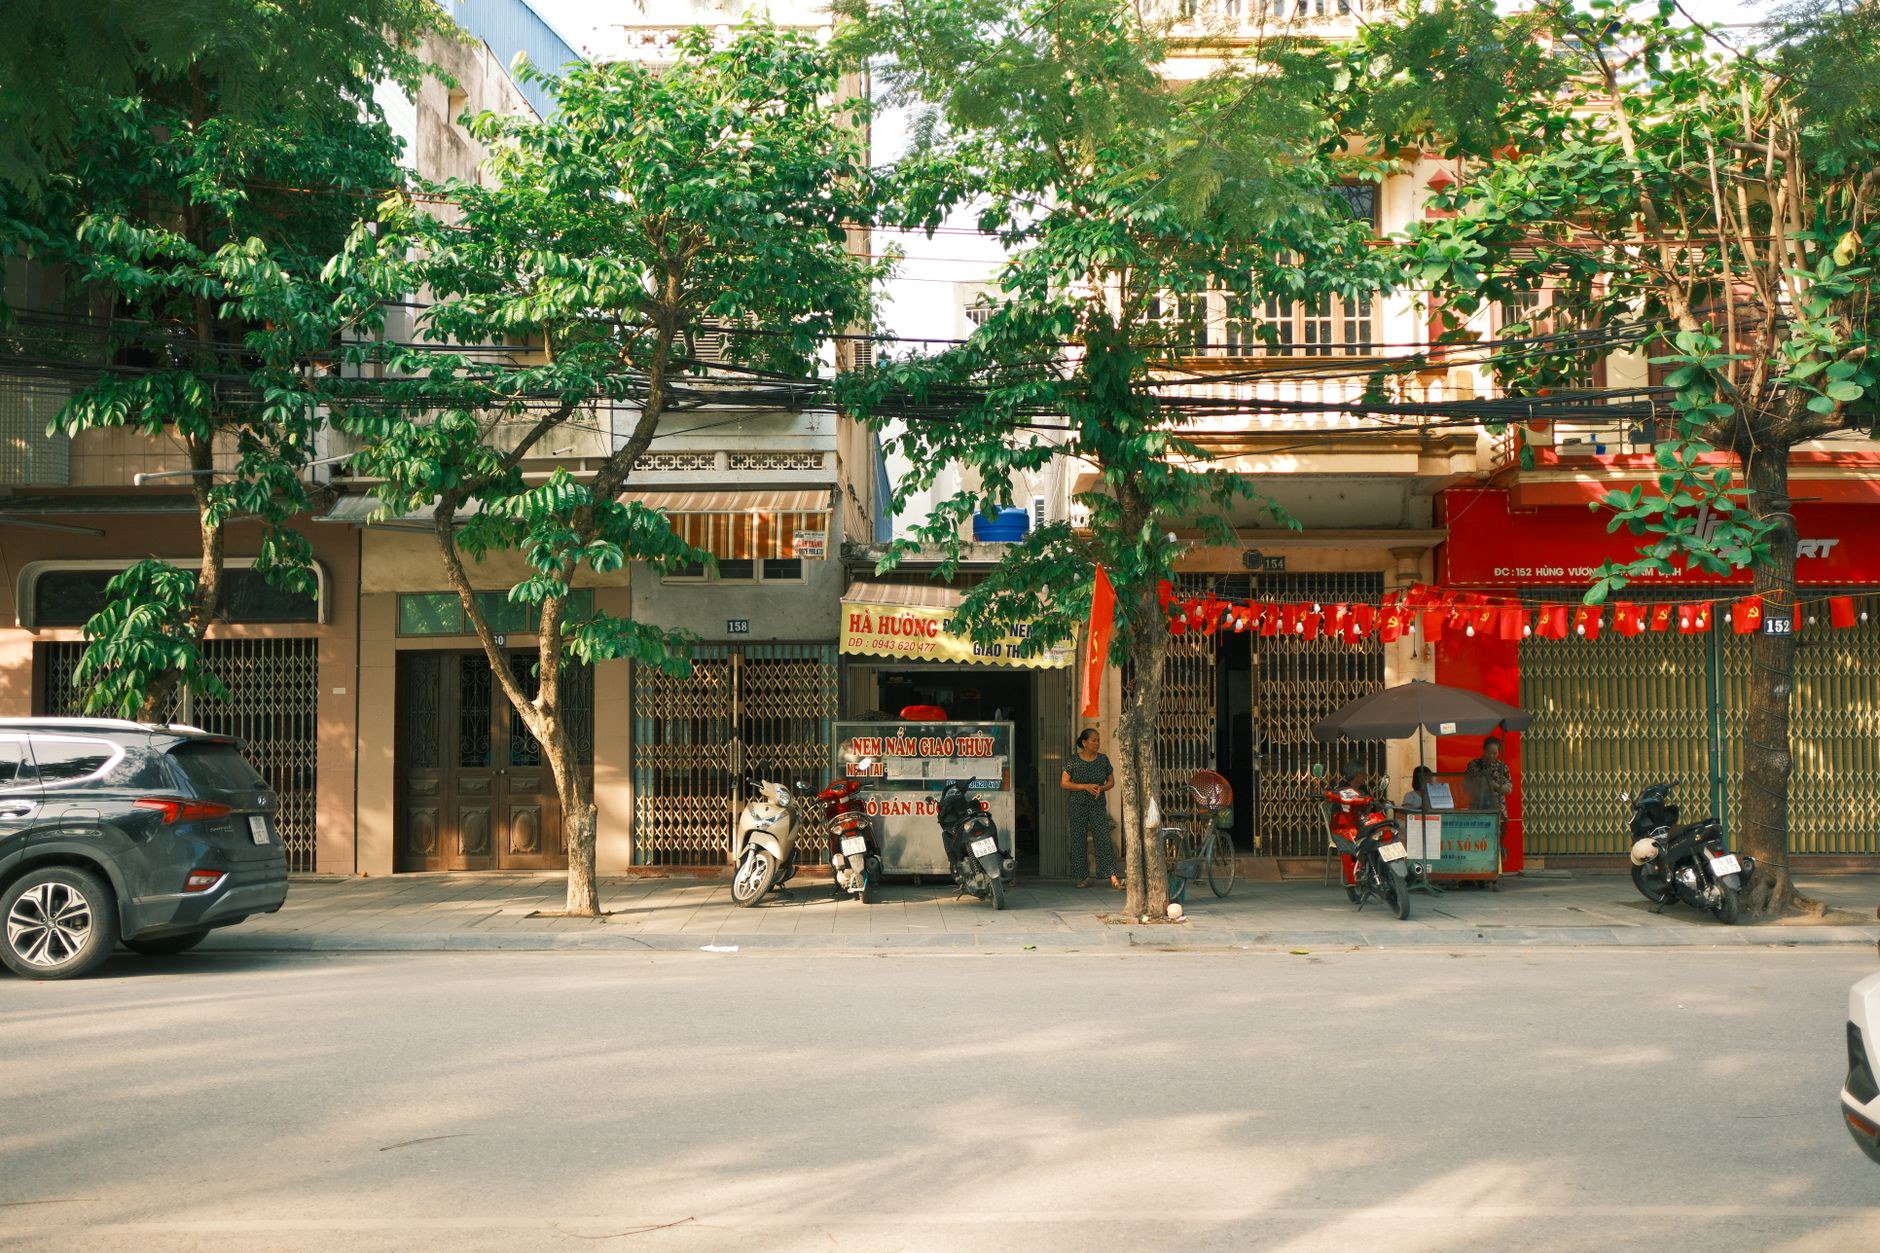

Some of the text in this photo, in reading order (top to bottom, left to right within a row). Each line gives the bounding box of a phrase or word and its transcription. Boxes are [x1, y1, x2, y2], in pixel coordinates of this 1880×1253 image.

[1265, 560, 1284, 569] 154
[729, 621, 747, 632] 158
[1767, 619, 1790, 633] 152
[872, 640, 895, 650] 0943
[898, 641, 916, 651] 620
[918, 643, 936, 652] 477
[852, 736, 883, 757] NEM
[919, 736, 955, 757] GIAO
[881, 796, 912, 816] BÁN
